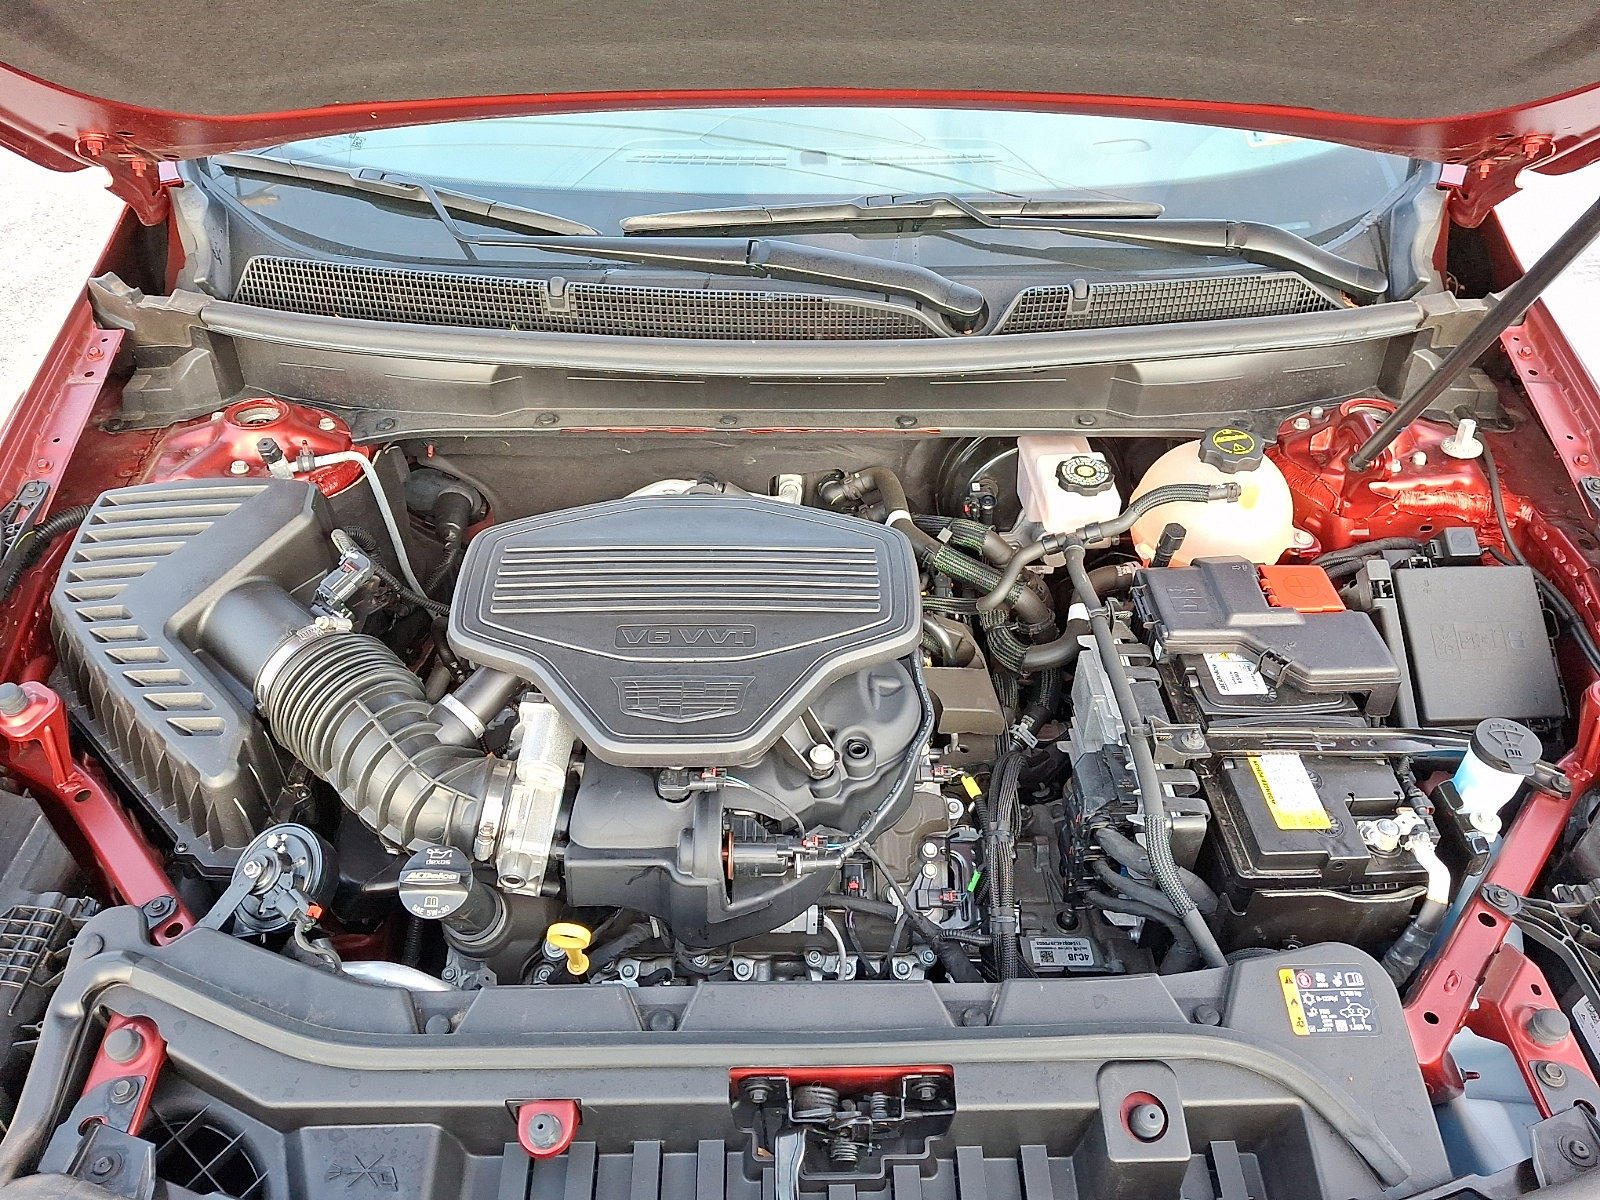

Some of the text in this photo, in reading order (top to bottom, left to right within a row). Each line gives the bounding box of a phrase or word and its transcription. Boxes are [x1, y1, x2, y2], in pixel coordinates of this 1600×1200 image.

[621, 629, 752, 644] V6 VVT
[404, 872, 457, 881] ACDelco
[411, 904, 451, 917] SAE 5W-30
[1067, 953, 1090, 961] 4CJB
